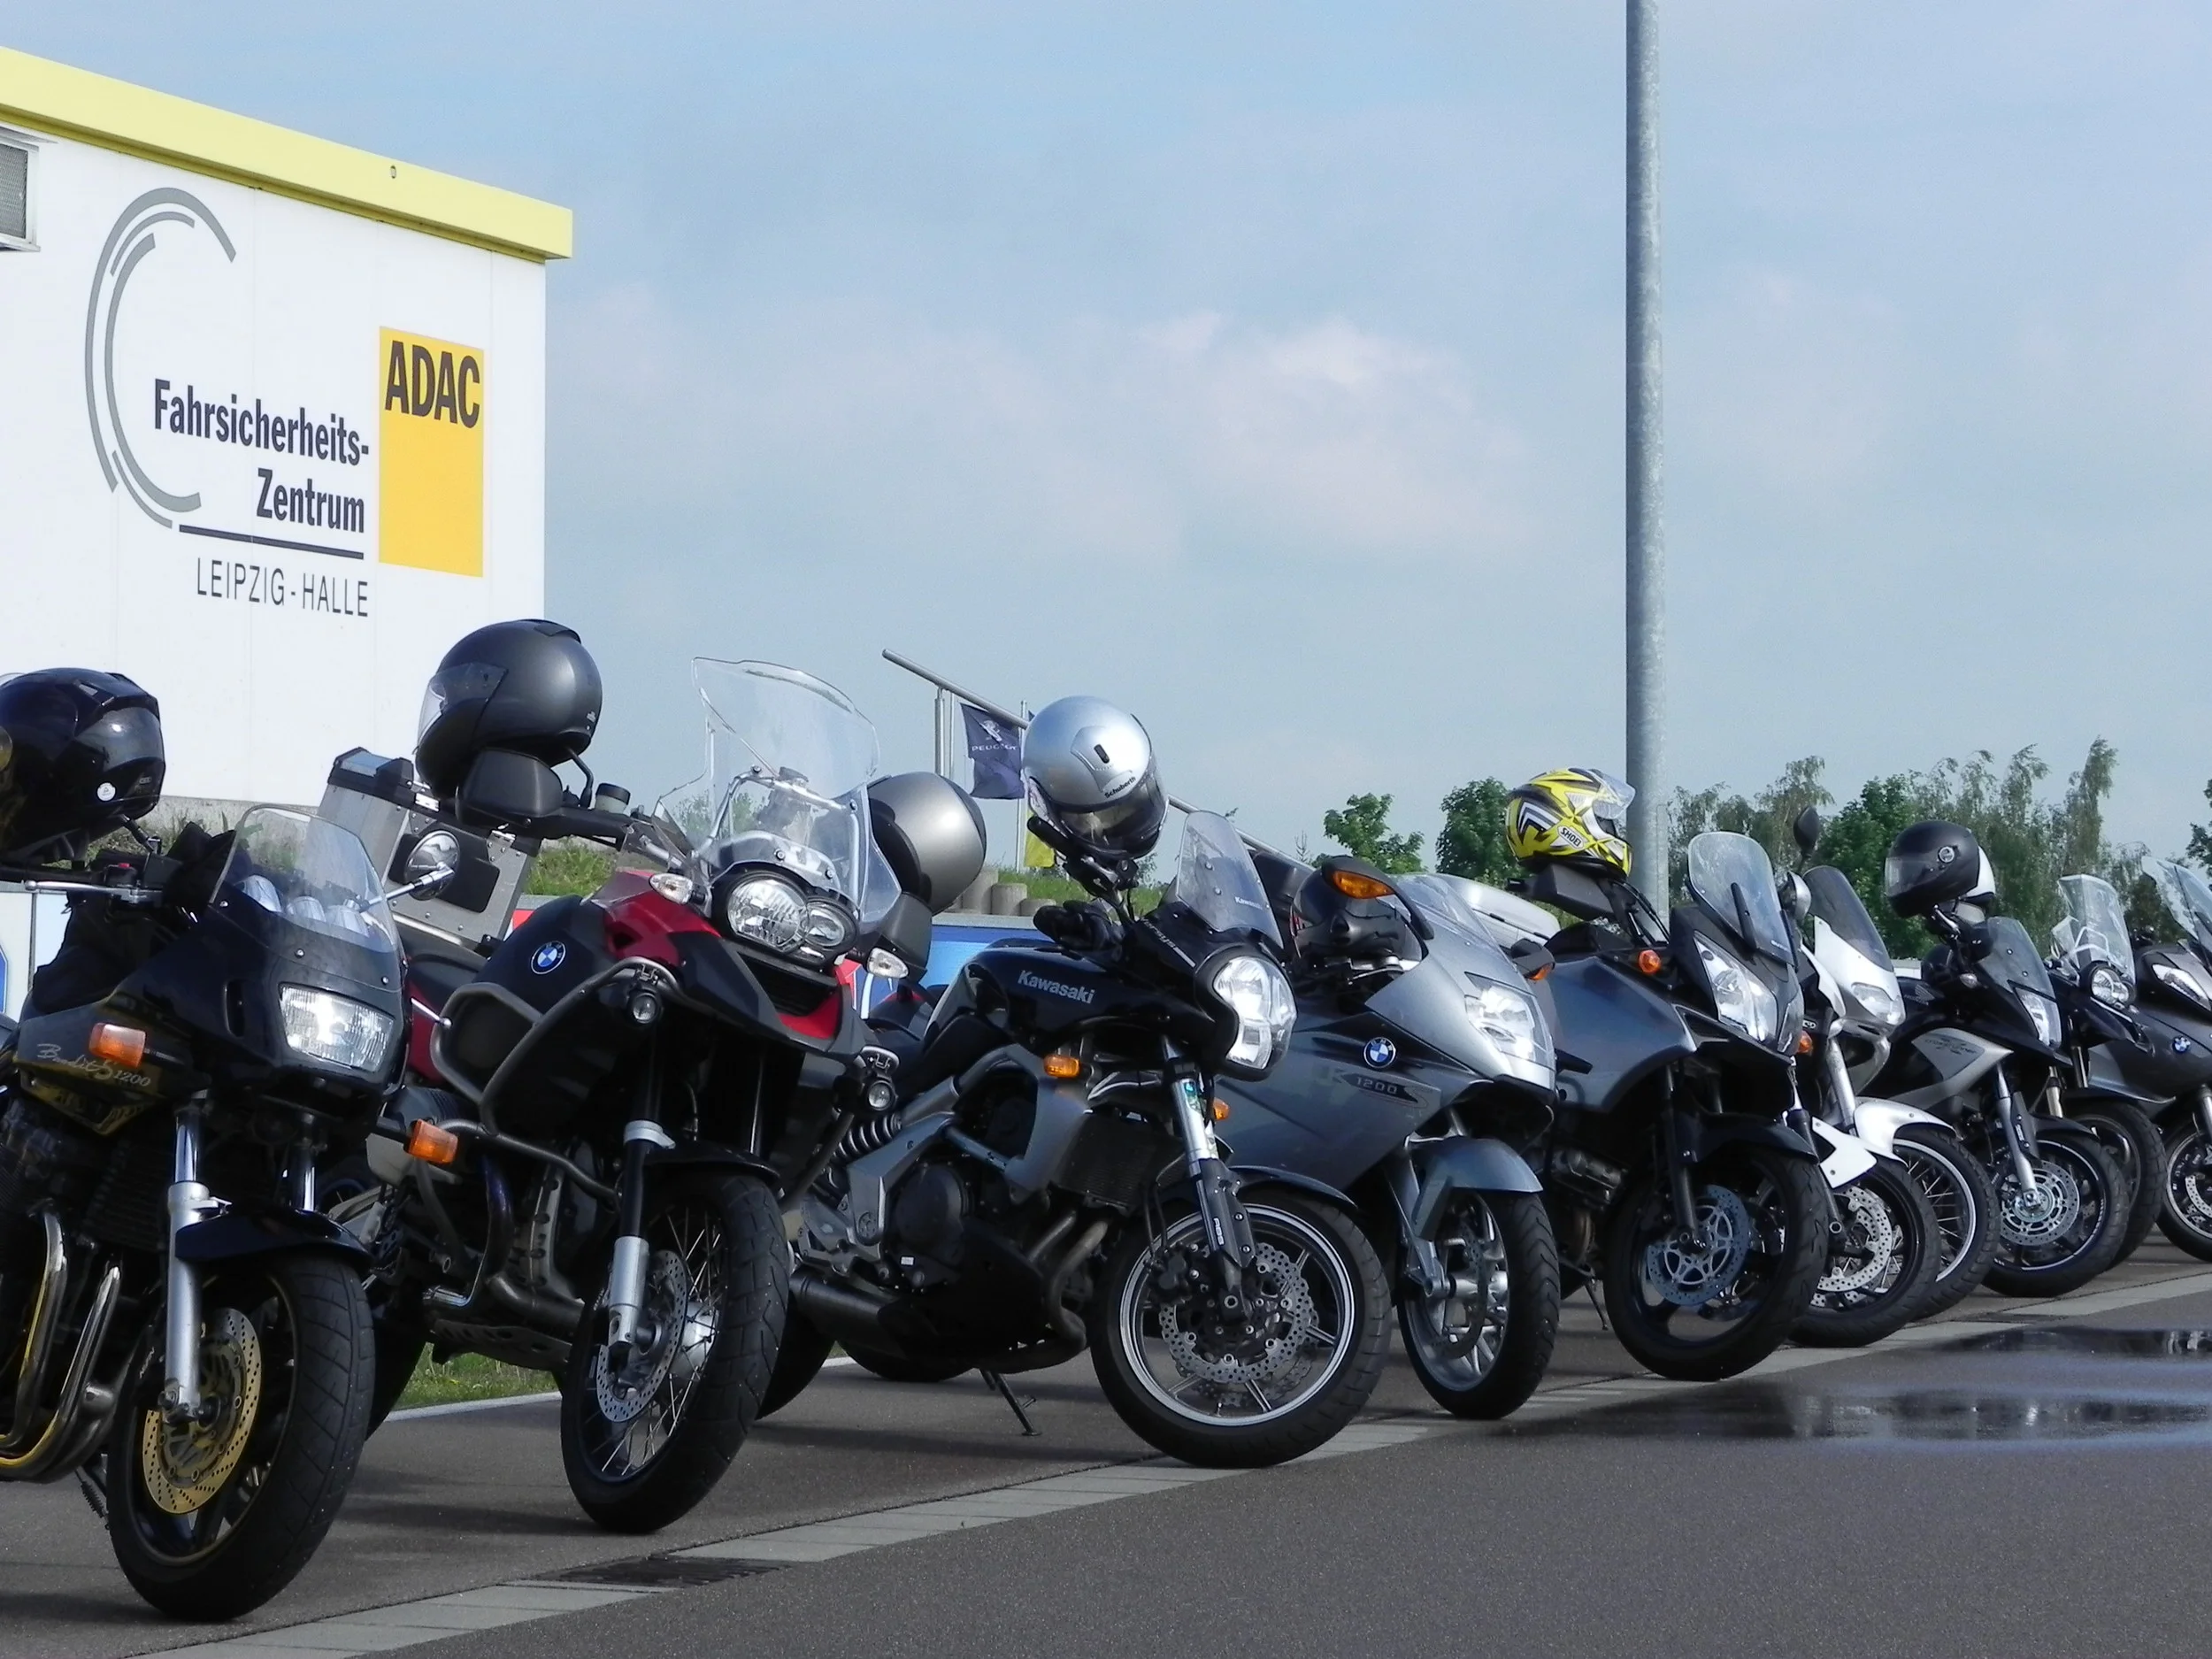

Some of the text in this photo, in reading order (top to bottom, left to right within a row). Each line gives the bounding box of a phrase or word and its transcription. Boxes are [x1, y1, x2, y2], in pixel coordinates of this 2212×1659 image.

[384, 340, 480, 429] ADAC
[154, 378, 370, 466] Fahrsicherheits-
[256, 468, 365, 534] Zentrum
[1104, 775, 1136, 799] Schuberth
[1560, 827, 1582, 847] SHOEI
[1018, 970, 1095, 1004] Kawasaki
[113, 1070, 151, 1087] 1200
[1356, 1076, 1398, 1094] 1200
